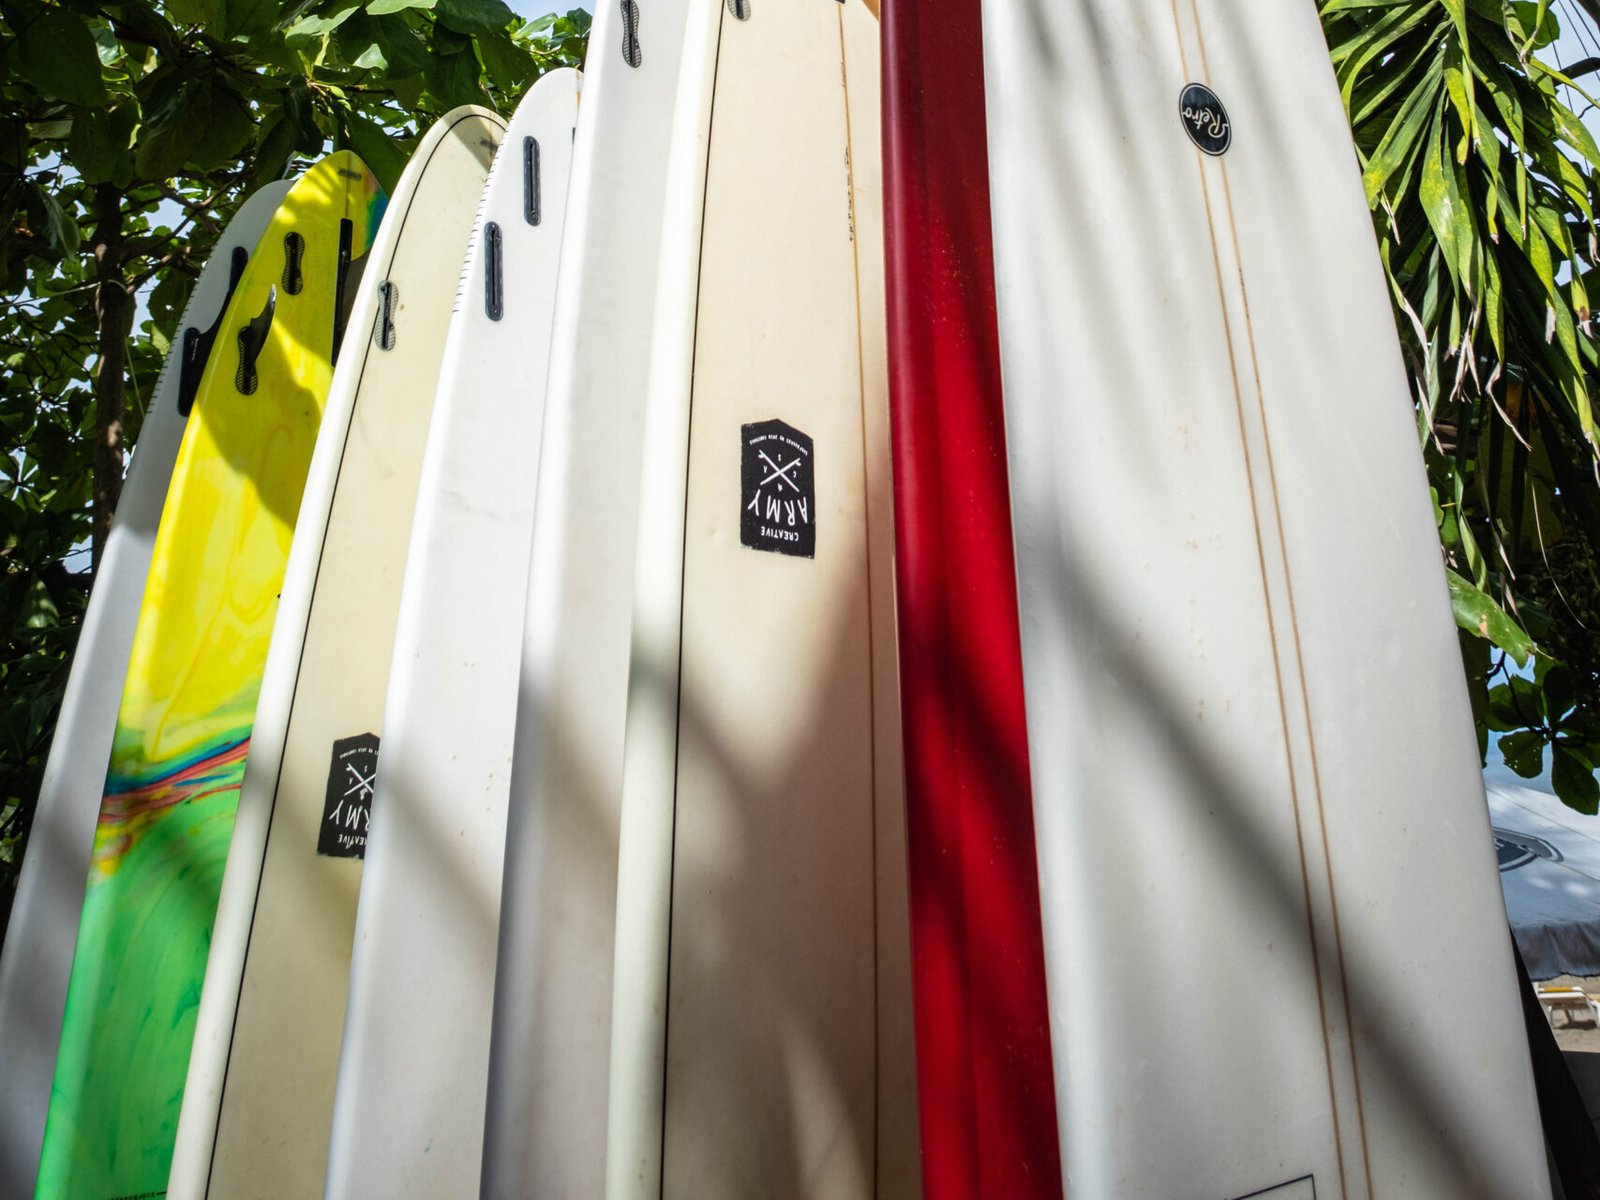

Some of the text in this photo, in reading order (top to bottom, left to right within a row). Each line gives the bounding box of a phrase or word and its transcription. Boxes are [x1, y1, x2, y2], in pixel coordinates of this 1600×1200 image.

[1181, 107, 1229, 138] Retro
[747, 489, 808, 526] ARMY
[760, 526, 799, 541] CREATIVE
[329, 799, 370, 832] RMY
